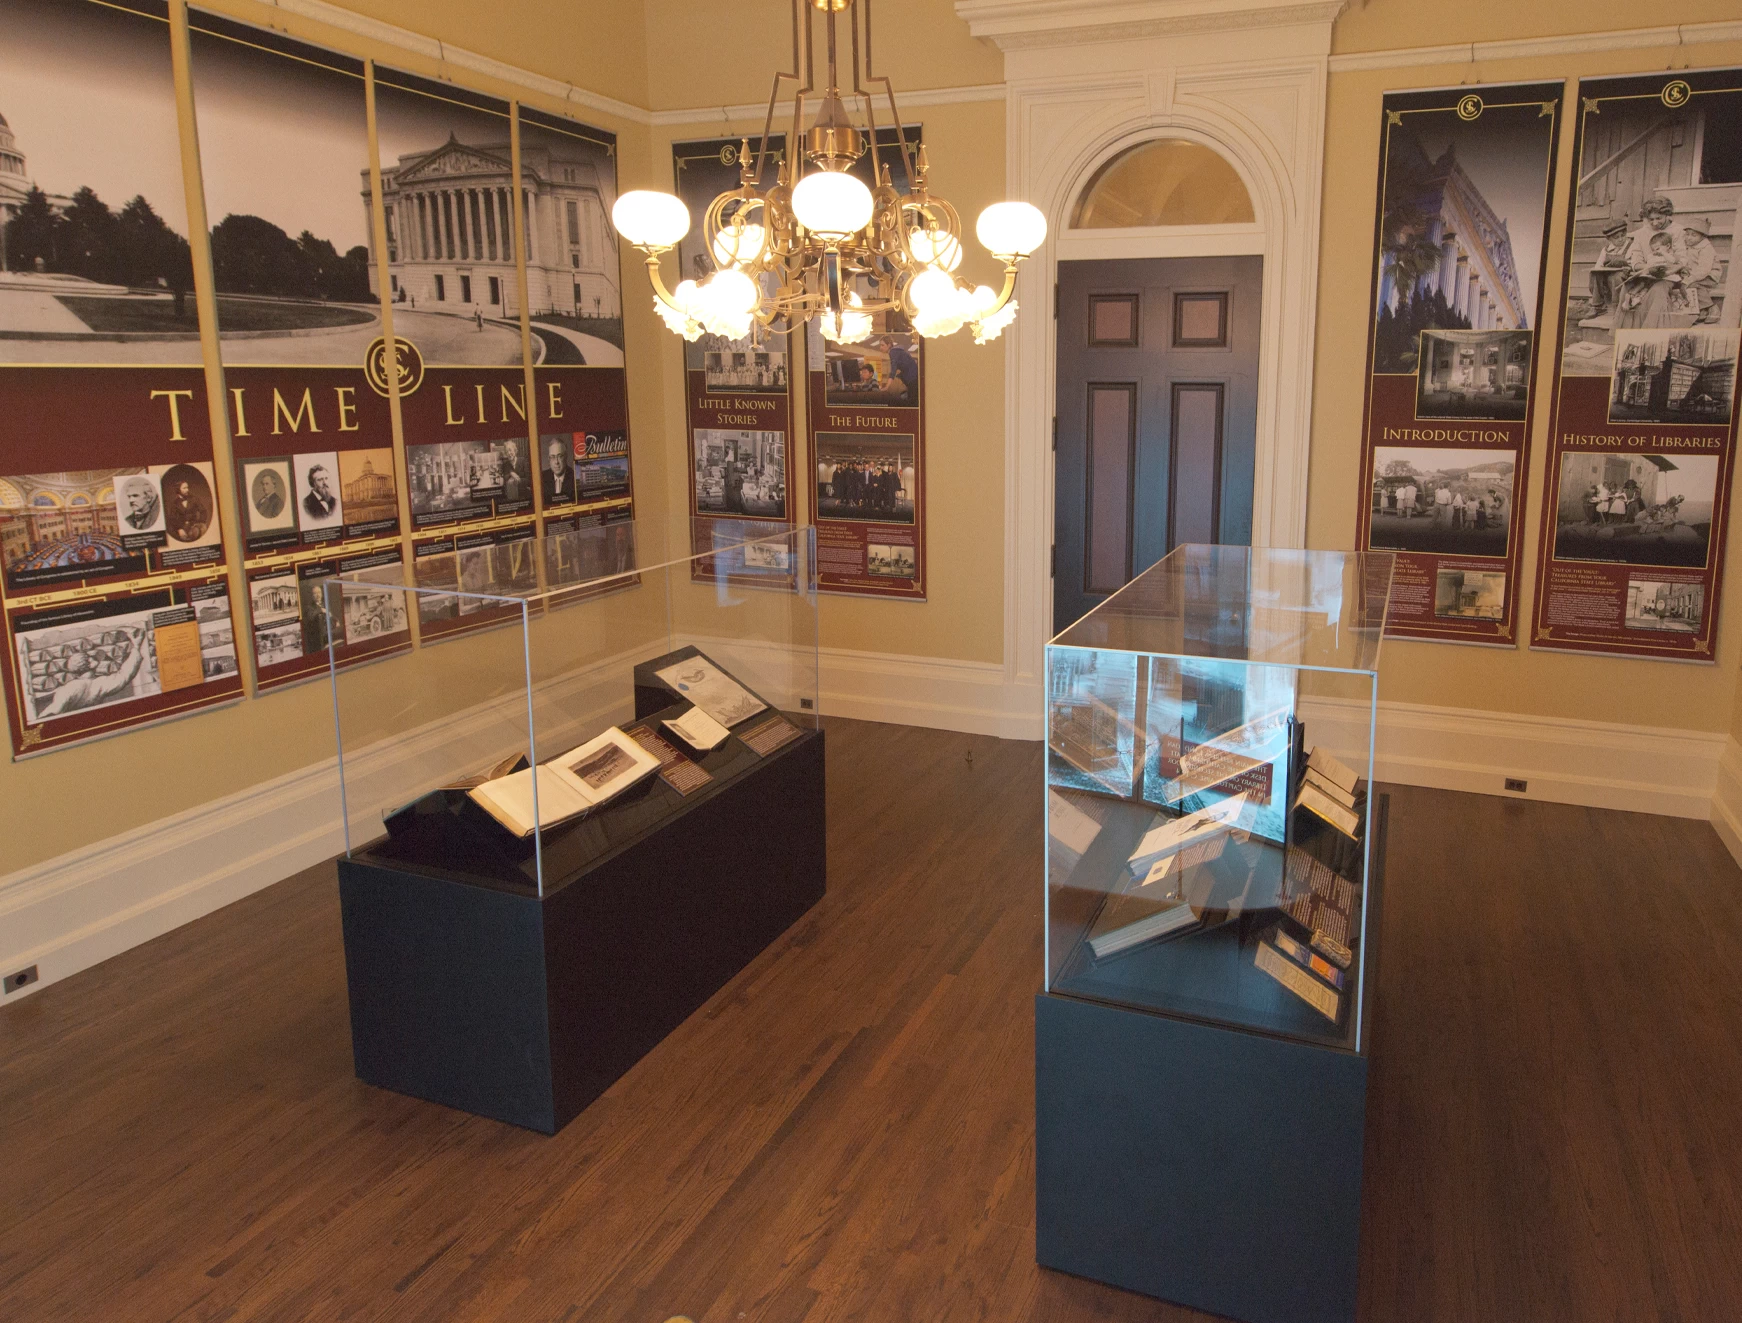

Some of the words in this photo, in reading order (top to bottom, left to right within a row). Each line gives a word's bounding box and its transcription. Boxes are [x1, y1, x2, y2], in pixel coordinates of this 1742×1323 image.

[150, 386, 359, 441] TIME
[442, 382, 564, 426] LINE
[698, 398, 731, 410] LITTLE
[735, 398, 776, 410] KNOWN
[717, 412, 757, 425] STORIES
[829, 415, 852, 427] THE
[856, 416, 898, 428] FUTURE
[1382, 426, 1510, 444] INTRODUCTION
[1562, 432, 1625, 448] HISTORY
[1628, 435, 1648, 448] OF
[1652, 434, 1722, 449] LIBRARIES
[574, 434, 627, 458] Bulletin
